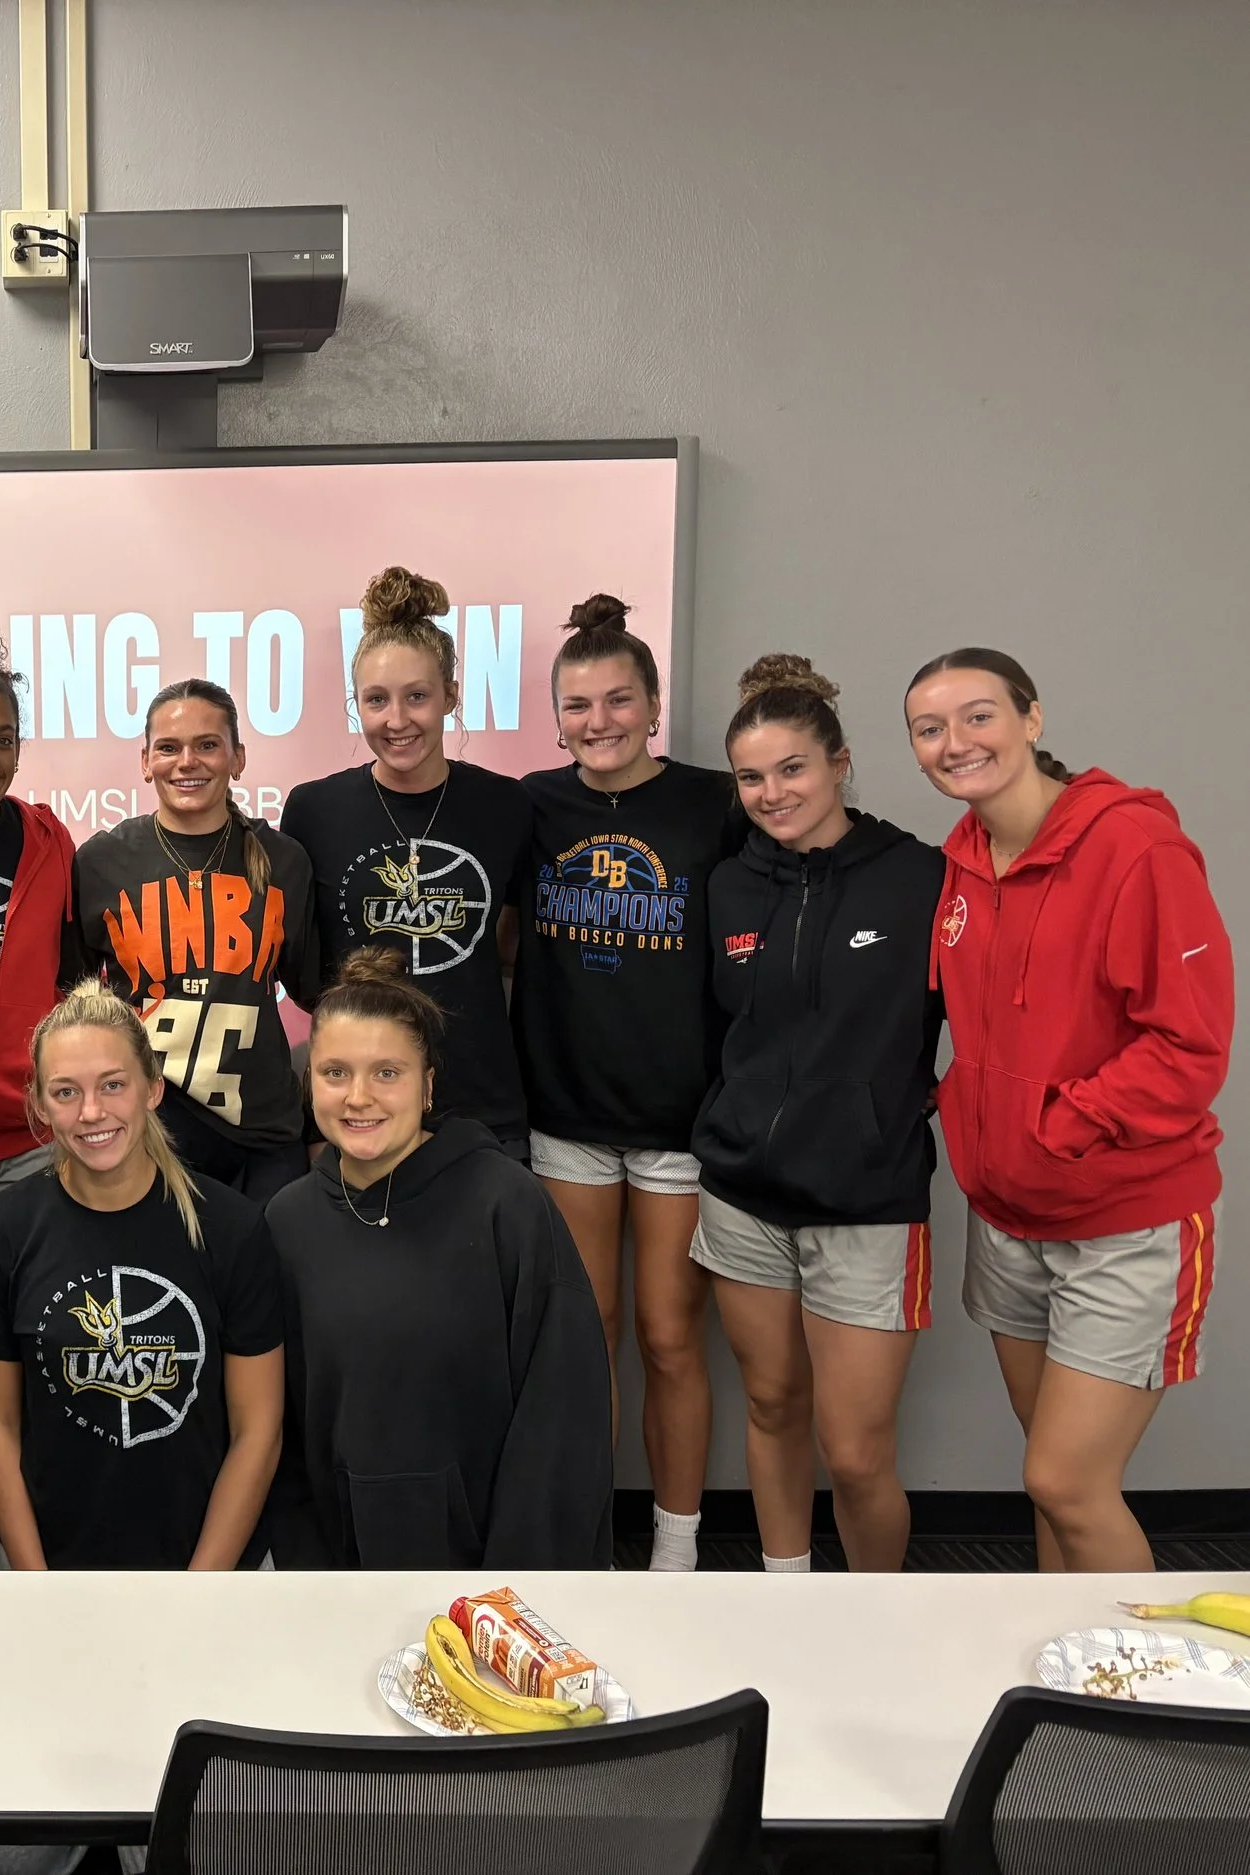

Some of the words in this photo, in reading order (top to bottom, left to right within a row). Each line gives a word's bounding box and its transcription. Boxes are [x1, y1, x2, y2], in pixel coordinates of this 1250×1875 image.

[149, 342, 193, 354] SMART
[193, 609, 305, 736] TO
[539, 863, 554, 880] 20
[590, 834, 610, 846] IOWA
[610, 834, 629, 846] STAR
[628, 837, 650, 856] NORTH
[646, 850, 668, 890] CONFERENCE
[338, 839, 406, 937] BASKETBALL
[424, 887, 464, 895] TRITONS
[673, 876, 689, 893] 25
[364, 898, 465, 937] UMSL
[536, 883, 685, 932] CHAMPIONS
[102, 870, 285, 995] WNBA
[535, 919, 557, 938] DON
[569, 926, 625, 947] BOSCO
[637, 934, 684, 950] DONS
[854, 930, 878, 942] NIKE
[182, 978, 209, 995] EST
[142, 998, 260, 1126] 96
[36, 1268, 107, 1394] BASKETBALL
[130, 1335, 176, 1345] TRITONS
[63, 1347, 179, 1399] UMSL
[64, 1406, 119, 1446] UMSL
